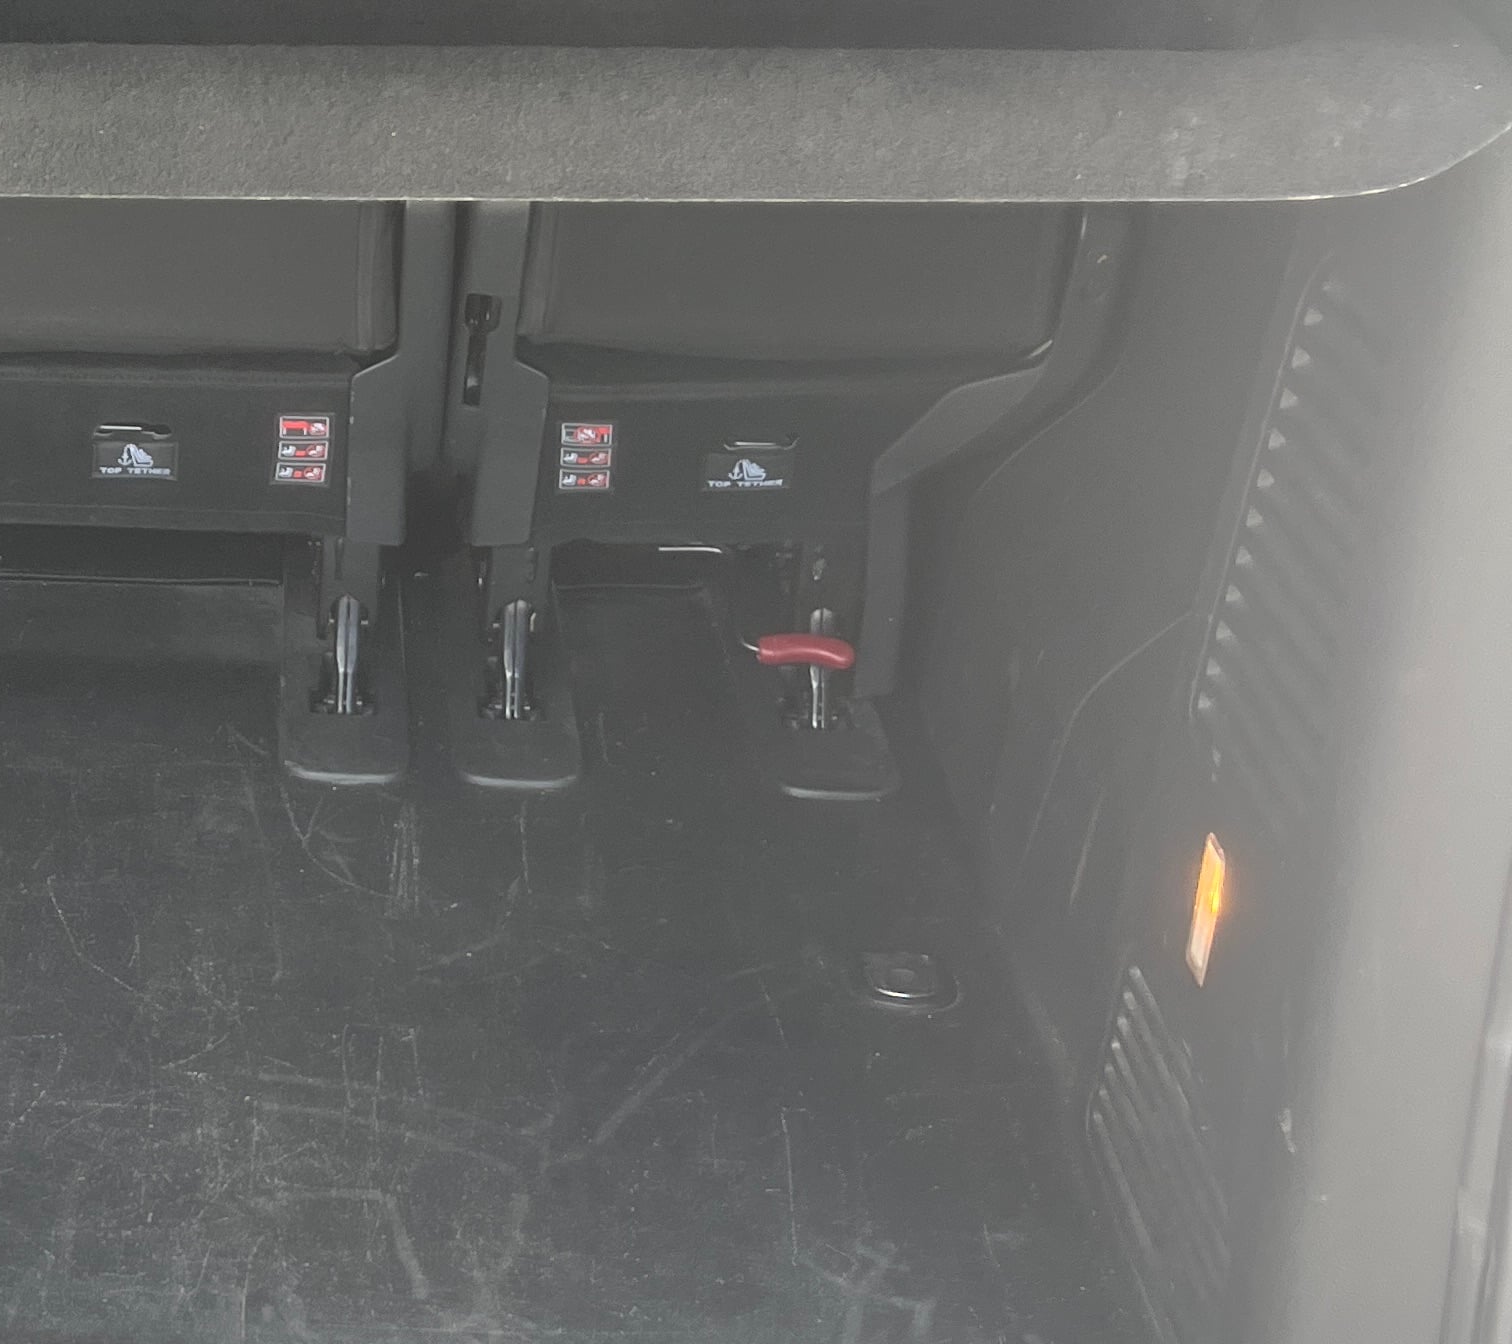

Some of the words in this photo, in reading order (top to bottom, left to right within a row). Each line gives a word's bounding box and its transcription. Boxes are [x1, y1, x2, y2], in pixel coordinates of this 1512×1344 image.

[99, 466, 123, 475] TOP
[127, 466, 172, 476] TETHER
[707, 480, 731, 488] TOP
